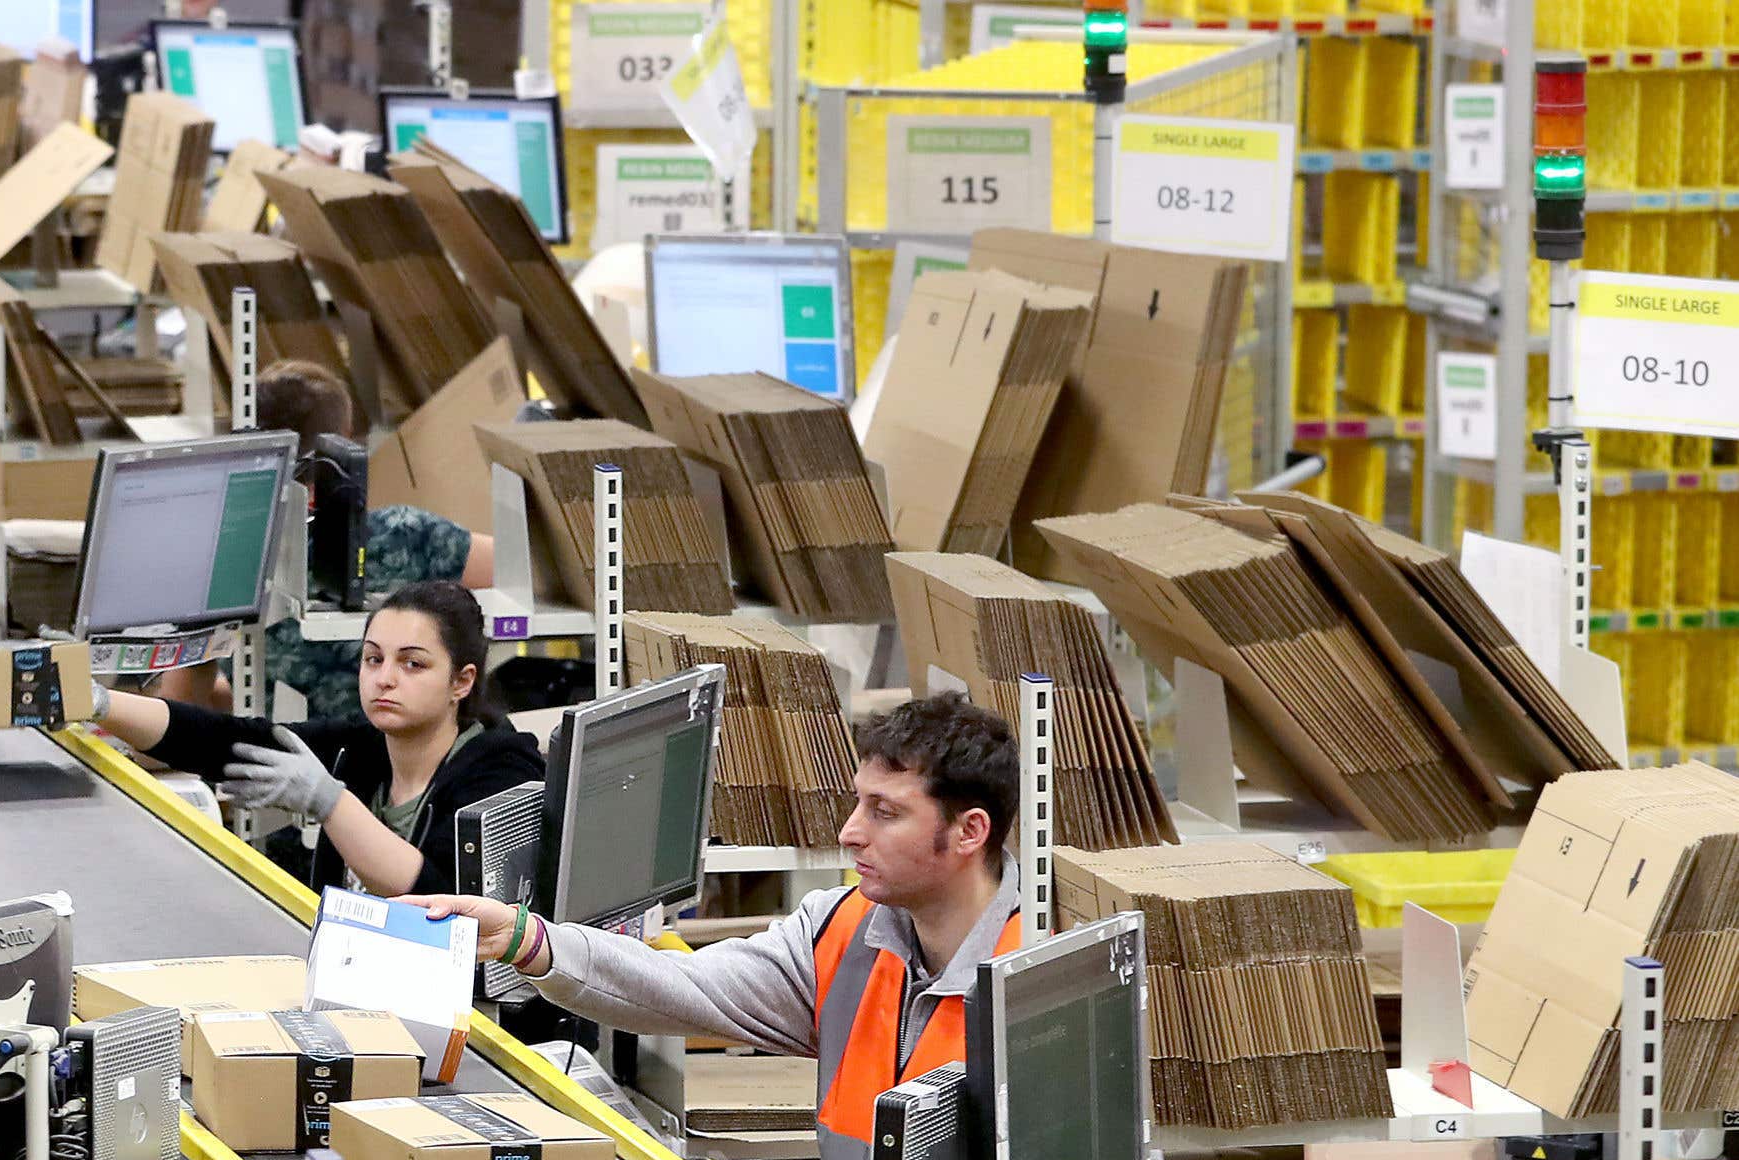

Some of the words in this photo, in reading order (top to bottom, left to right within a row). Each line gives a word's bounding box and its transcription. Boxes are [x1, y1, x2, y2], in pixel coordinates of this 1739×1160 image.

[1152, 133, 1198, 147] SINGLE
[1203, 135, 1246, 150] LARGE
[941, 176, 999, 204] 115
[1157, 185, 1235, 214] 08-12
[1615, 294, 1668, 312] SINGLE
[1672, 299, 1721, 316] LARGE
[1623, 355, 1710, 387] 08-10
[1435, 1119, 1458, 1134] C4
